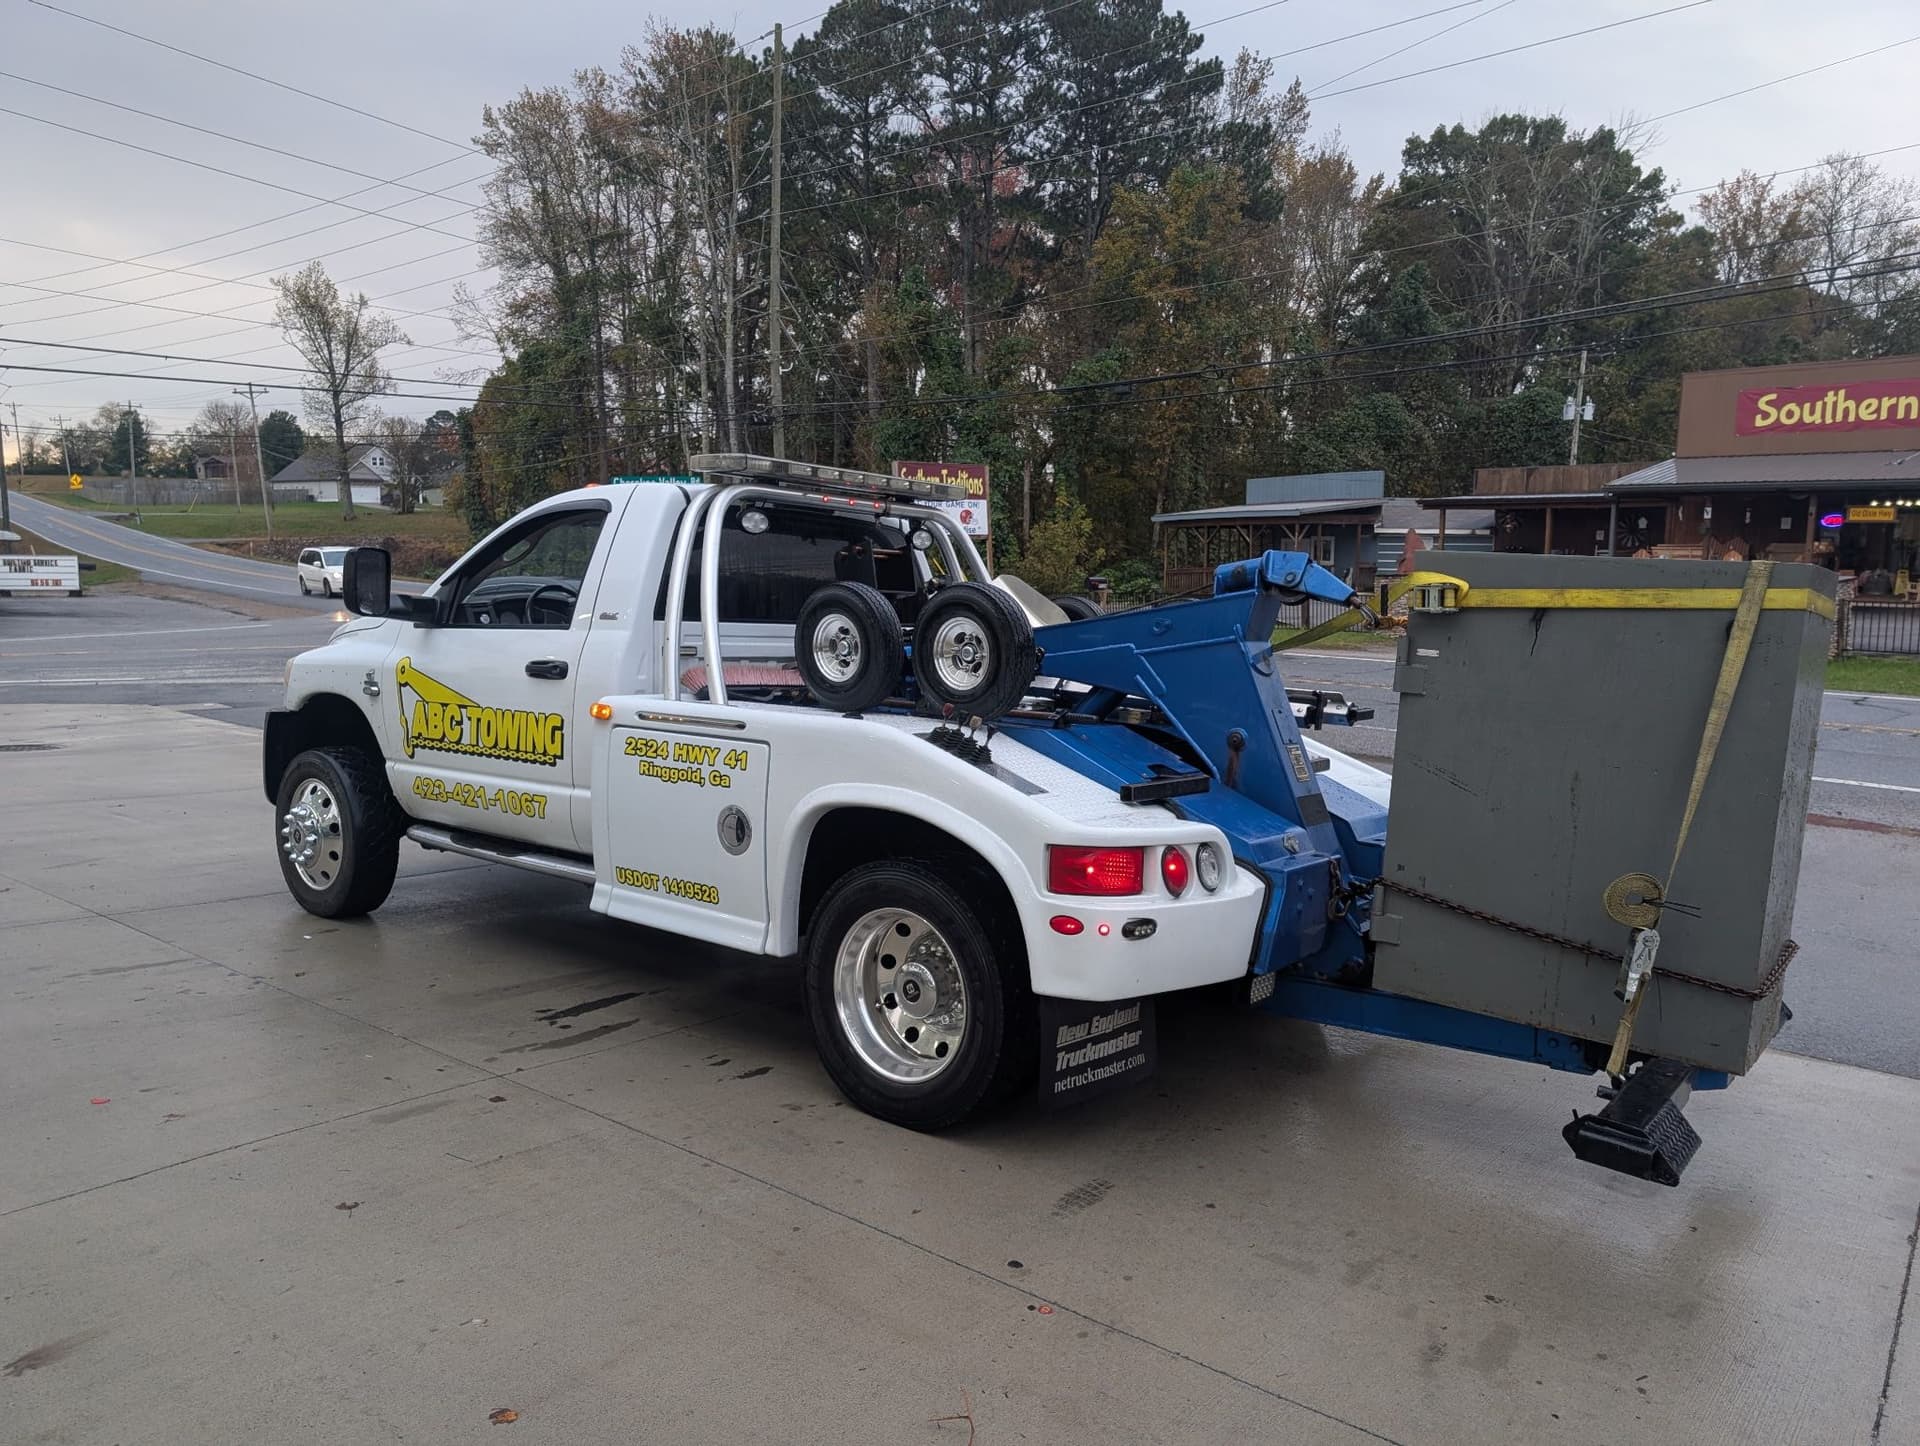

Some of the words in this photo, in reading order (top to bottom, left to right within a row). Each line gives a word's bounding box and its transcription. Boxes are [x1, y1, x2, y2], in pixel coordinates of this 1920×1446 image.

[1754, 388, 1919, 427] Southern
[412, 700, 463, 742] ABC
[465, 706, 564, 760] TOWING
[624, 736, 669, 760] 2524
[673, 743, 720, 766] HWY
[723, 750, 748, 770] 41
[639, 760, 705, 787] Ringgold,
[708, 771, 731, 787] Ga
[412, 776, 548, 819] 423-421-1067
[616, 866, 659, 891] USDOT
[662, 876, 719, 904] 1419528
[1056, 1022, 1089, 1044] New
[1090, 1002, 1140, 1033] England
[1056, 1030, 1142, 1071] Truckmaster
[1054, 1053, 1145, 1093] netruckmaster.com
